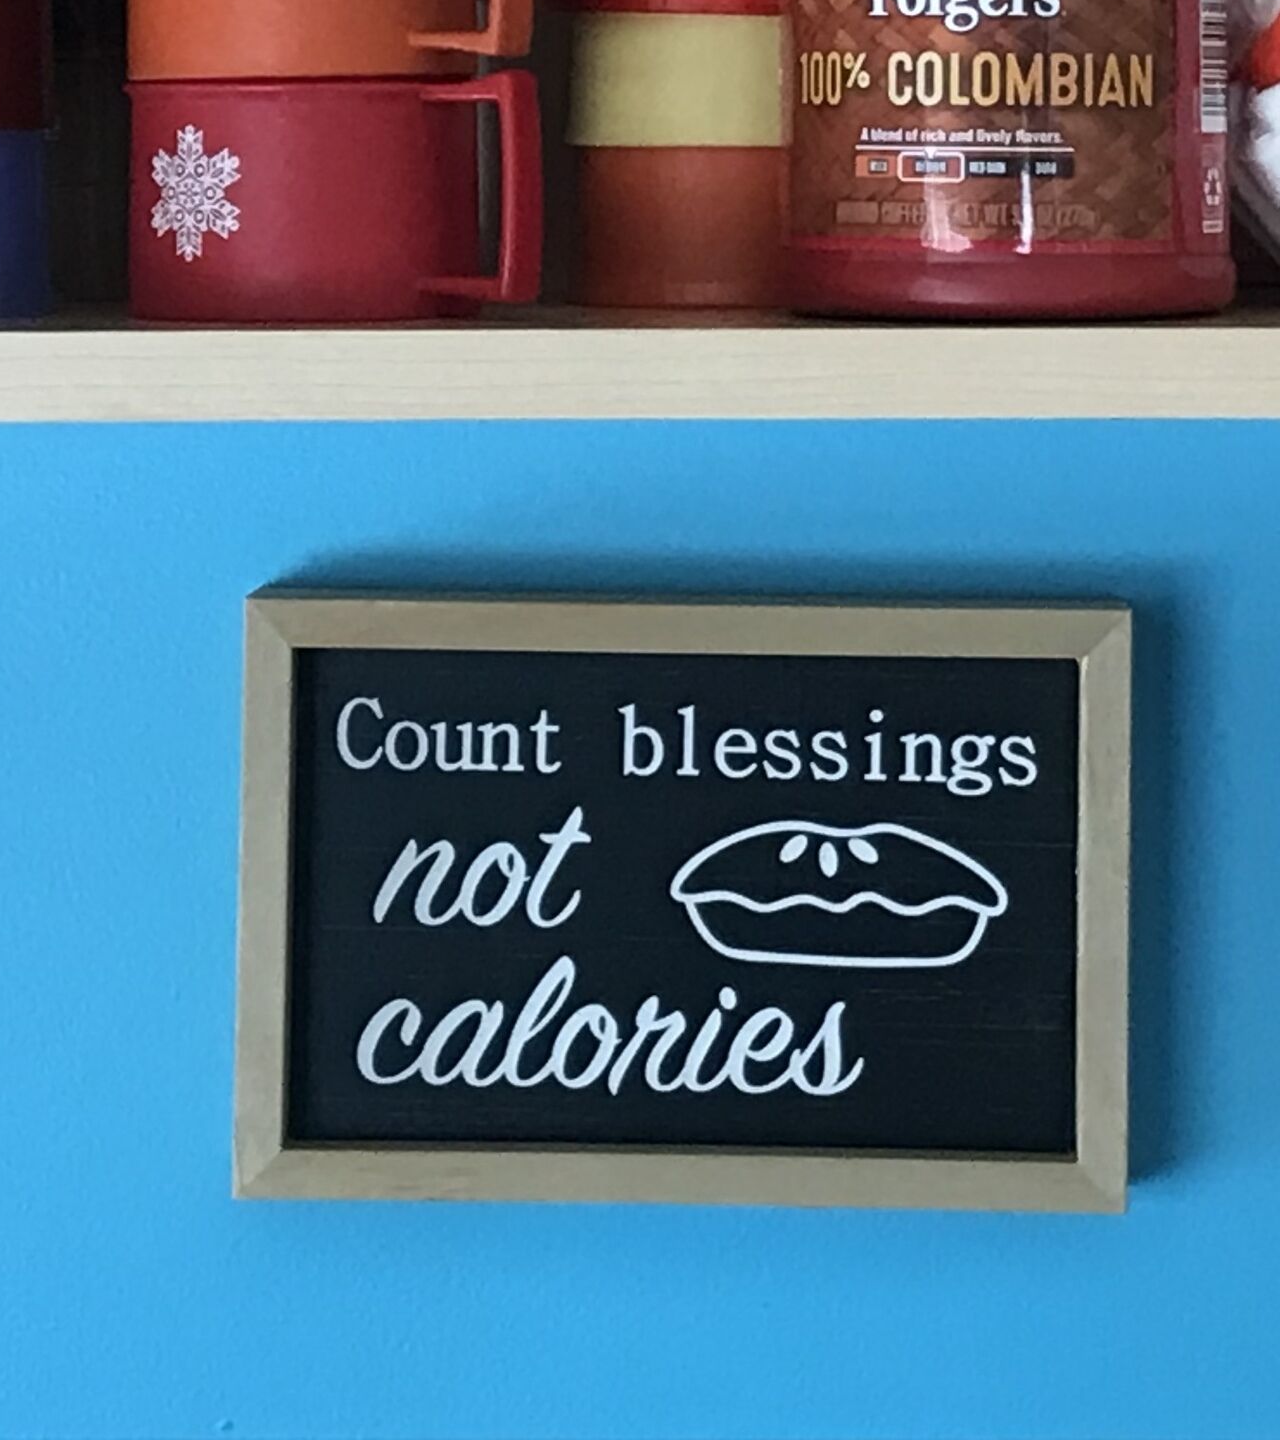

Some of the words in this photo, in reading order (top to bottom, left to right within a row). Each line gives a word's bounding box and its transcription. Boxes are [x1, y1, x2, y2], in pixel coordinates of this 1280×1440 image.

[801, 51, 870, 106] 100%
[887, 51, 1153, 108] COLOMBIAN
[860, 128, 868, 141] A
[871, 128, 903, 142] blend
[905, 128, 918, 142] of
[920, 129, 946, 142] rich
[948, 129, 974, 143] and
[976, 129, 1012, 145] lively
[1015, 129, 1064, 143] flavors.
[336, 696, 562, 772] Count
[619, 704, 1039, 797] blessings
[373, 806, 592, 928] not
[355, 955, 866, 1097] calories
